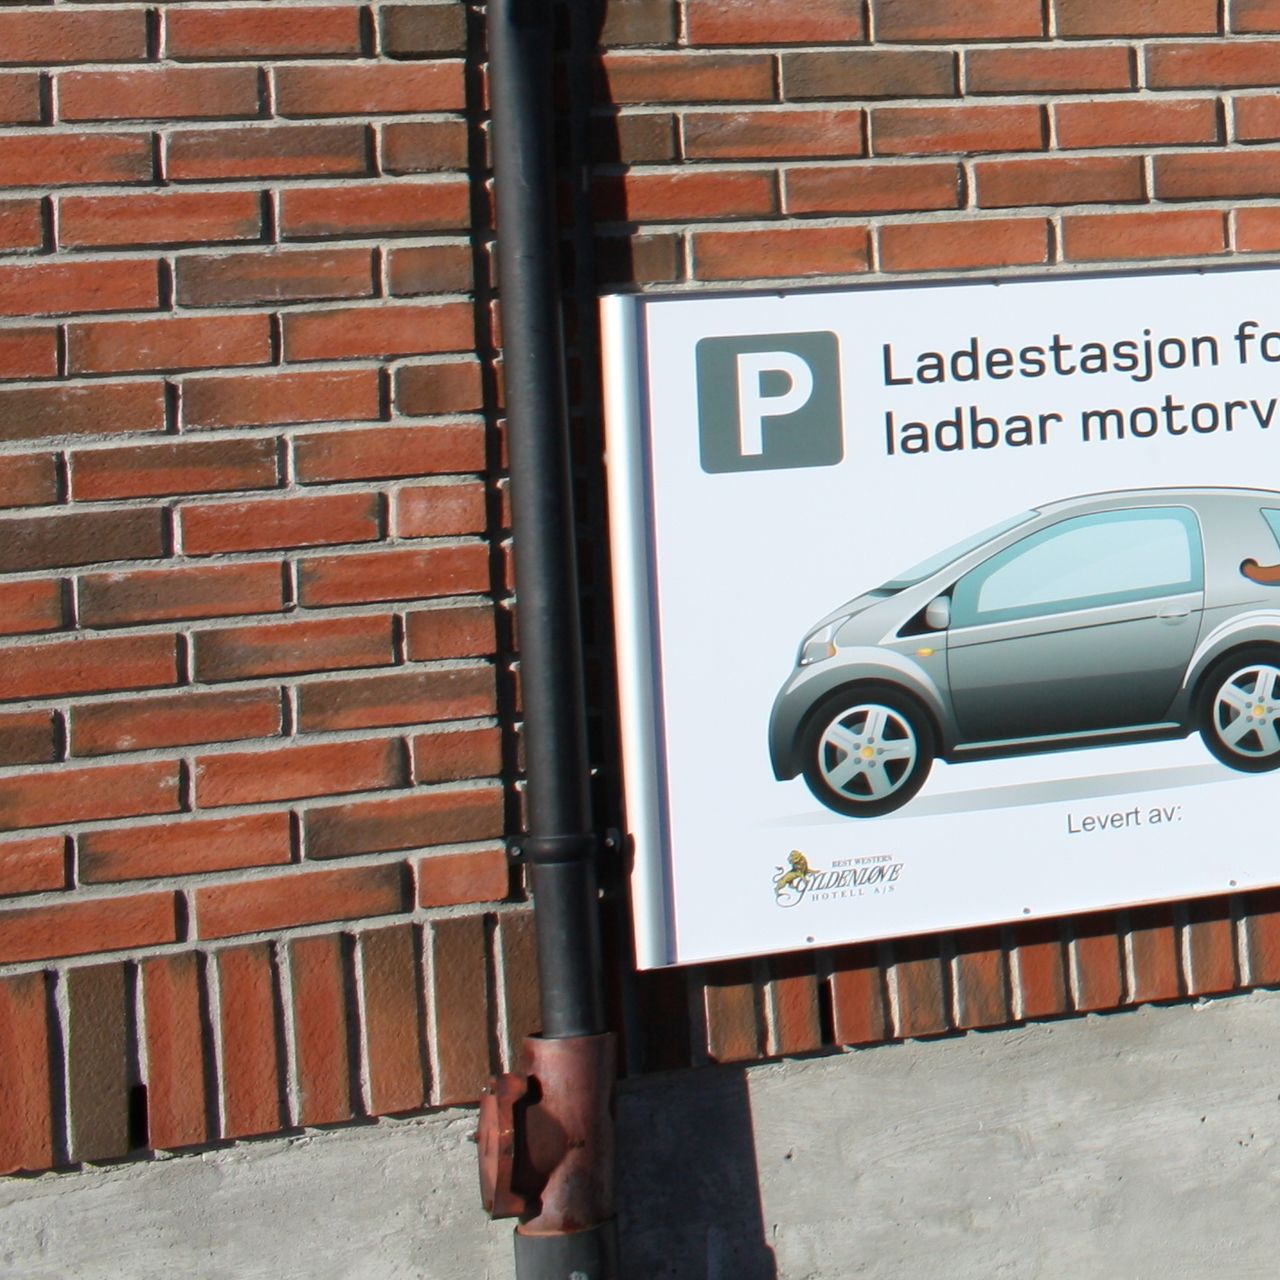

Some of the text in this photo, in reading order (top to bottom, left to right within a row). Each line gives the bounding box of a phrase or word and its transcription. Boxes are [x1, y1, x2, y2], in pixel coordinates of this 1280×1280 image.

[881, 328, 1220, 387] Ladestasjon
[735, 350, 814, 457] P
[883, 405, 1063, 456] ladbar
[1066, 803, 1183, 835] Levert av:
[831, 854, 894, 868] BEST WESTERN
[811, 884, 896, 902] HOTELL A/S
